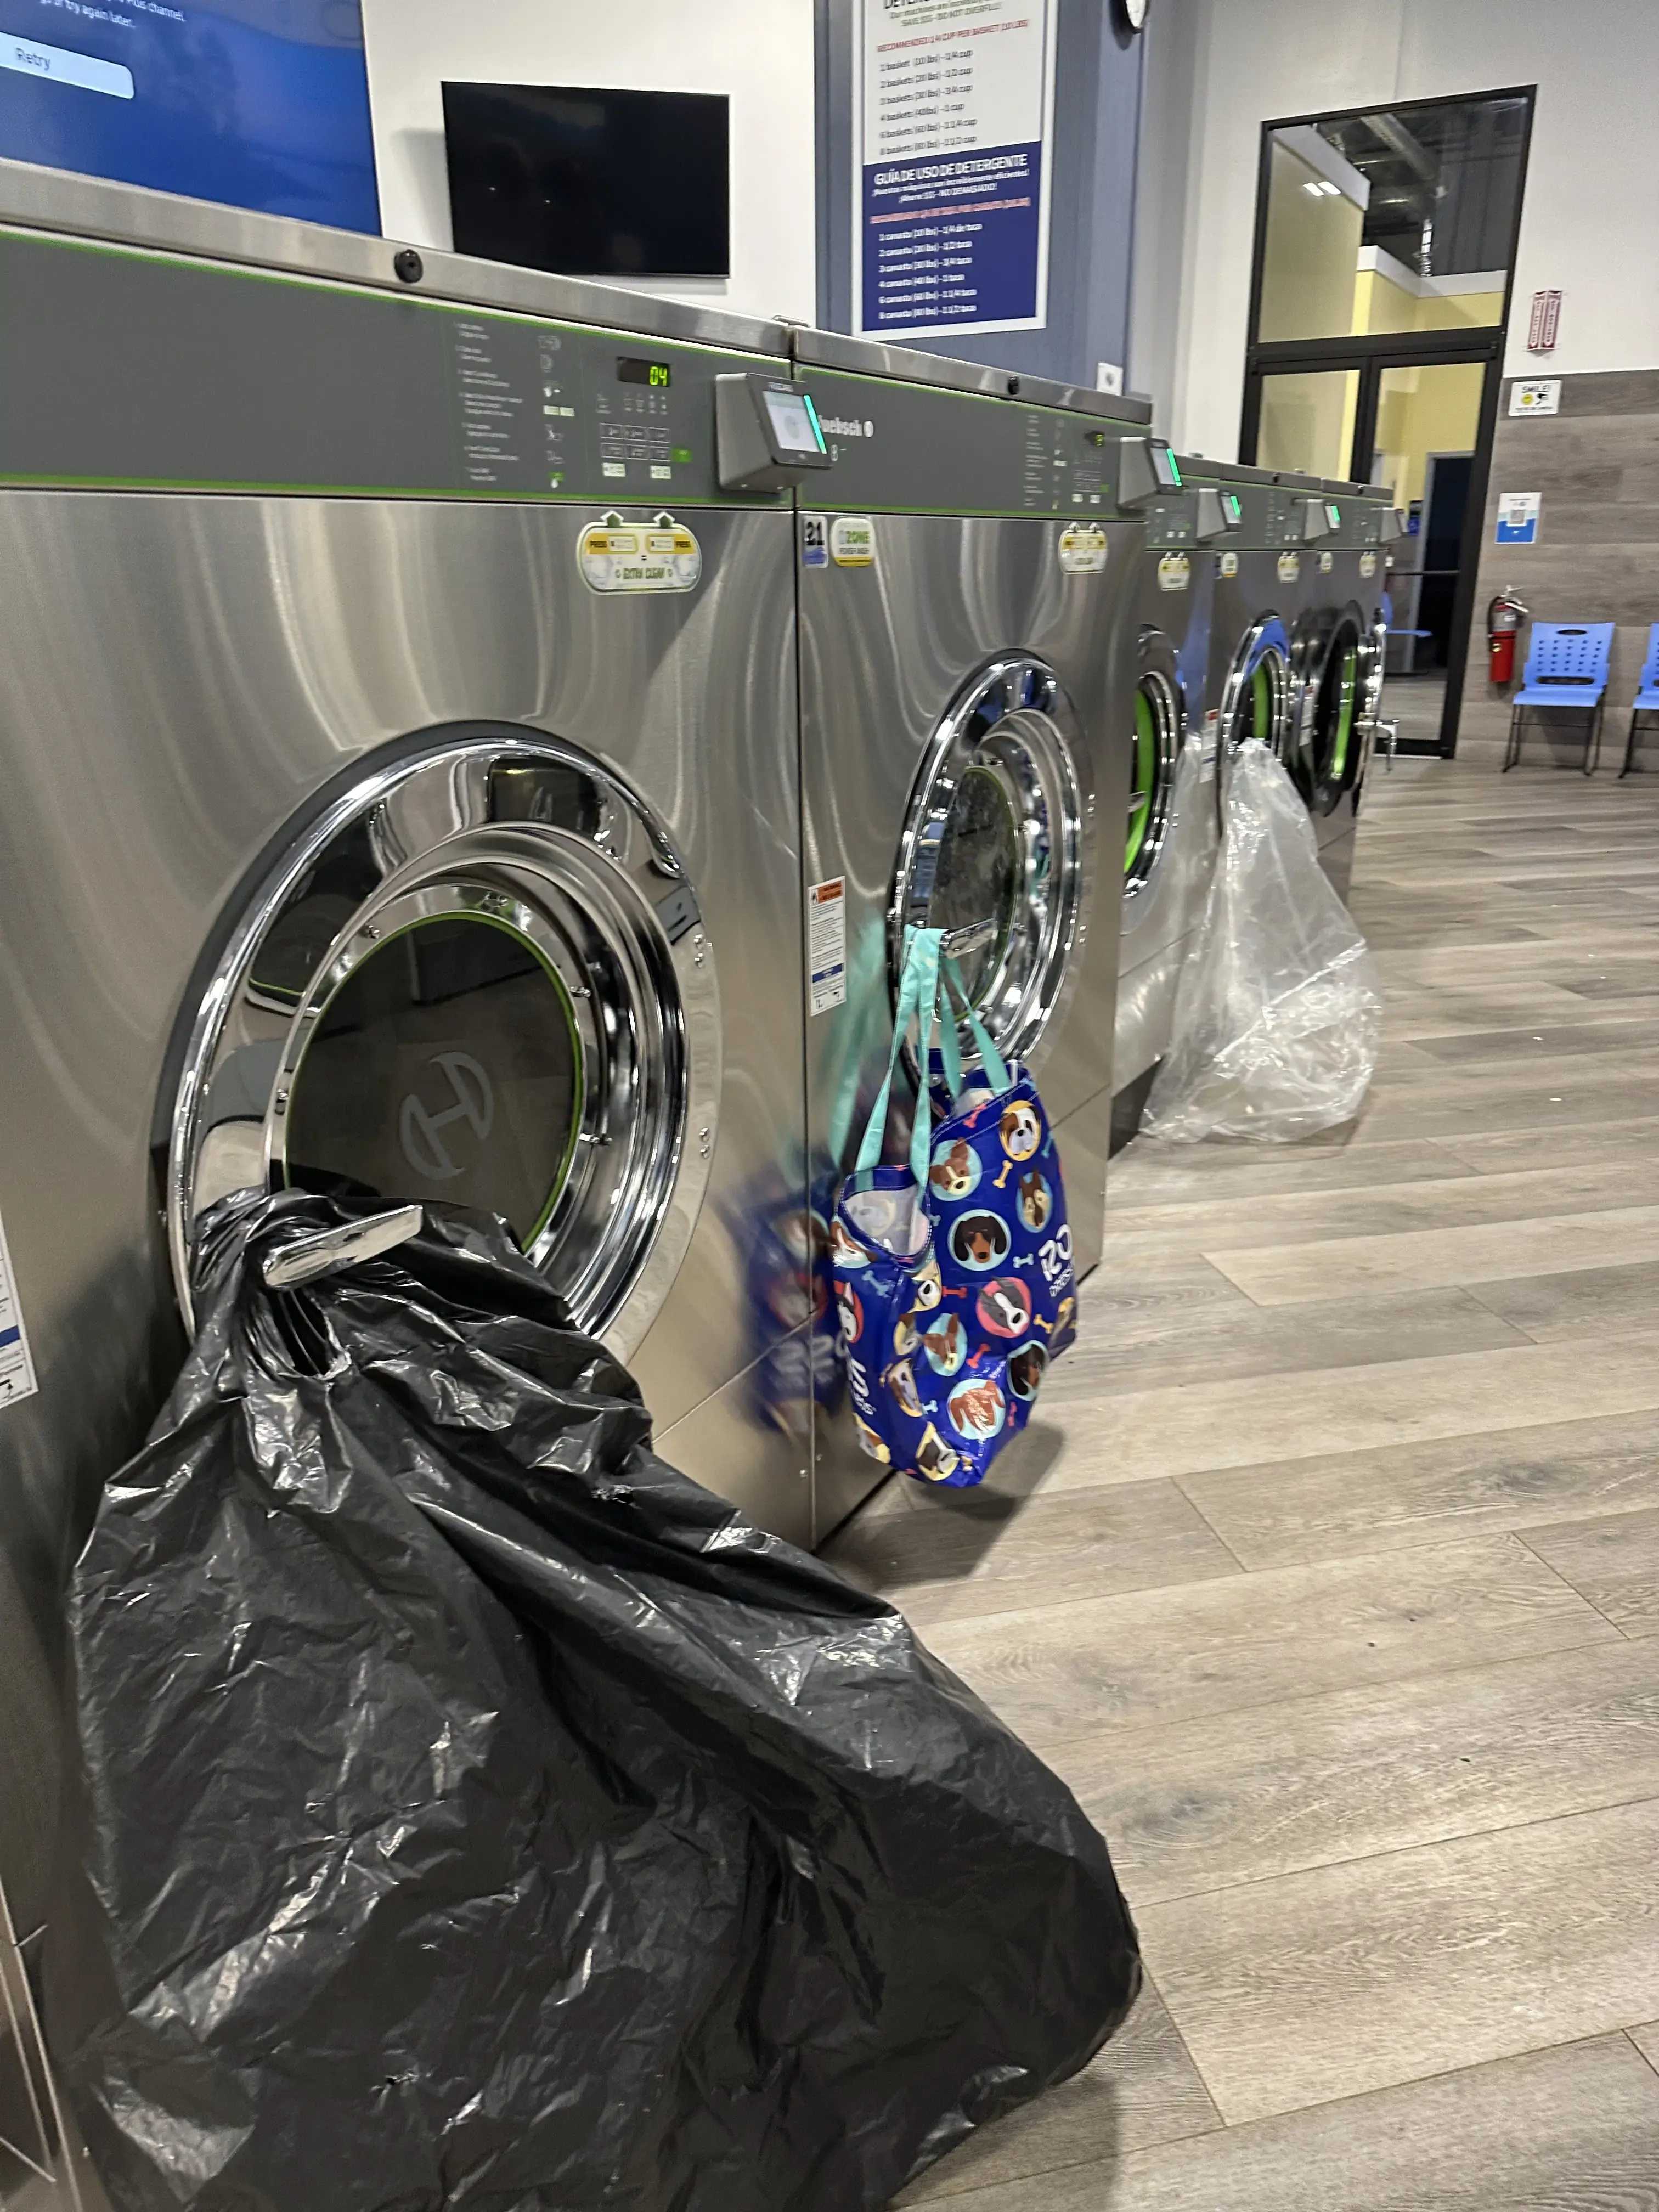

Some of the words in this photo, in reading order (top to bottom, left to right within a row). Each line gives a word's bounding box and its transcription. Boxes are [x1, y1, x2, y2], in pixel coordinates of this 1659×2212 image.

[82, 5, 109, 18] again
[15, 47, 50, 70] Retry
[874, 167, 900, 185] GUÍA
[901, 168, 915, 182] DE
[916, 165, 939, 179] USO
[939, 163, 955, 177] DE
[955, 153, 1028, 175] DETERGENTE
[650, 366, 668, 386] 04
[806, 522, 825, 546] 21
